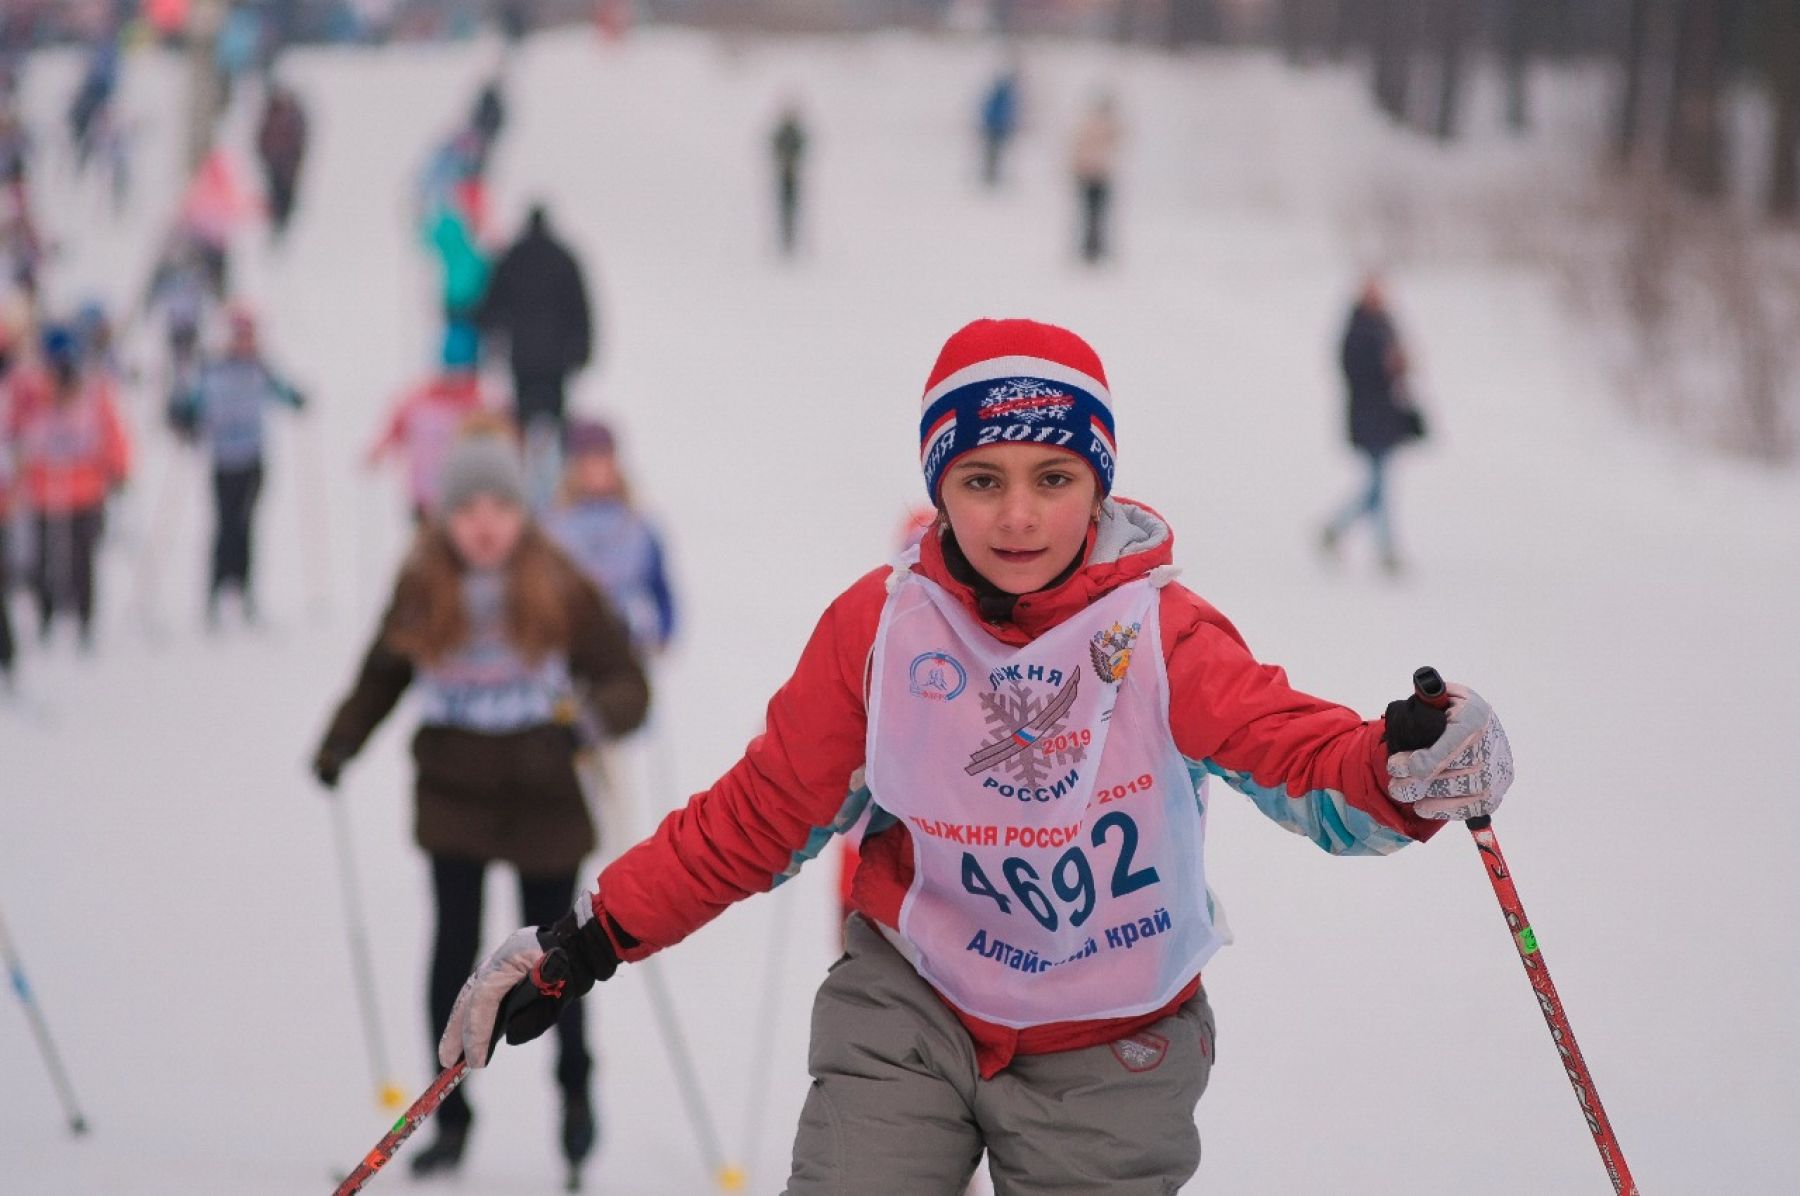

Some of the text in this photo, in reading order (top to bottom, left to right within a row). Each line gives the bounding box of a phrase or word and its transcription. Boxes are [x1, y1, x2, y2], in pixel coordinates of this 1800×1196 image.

[1042, 729, 1091, 755] 2019
[982, 769, 1079, 802] РОССИИ
[1005, 818, 1083, 848] РОССИ
[1097, 774, 1152, 804] 2019
[961, 811, 1160, 933] 4692
[1104, 907, 1172, 949] край
